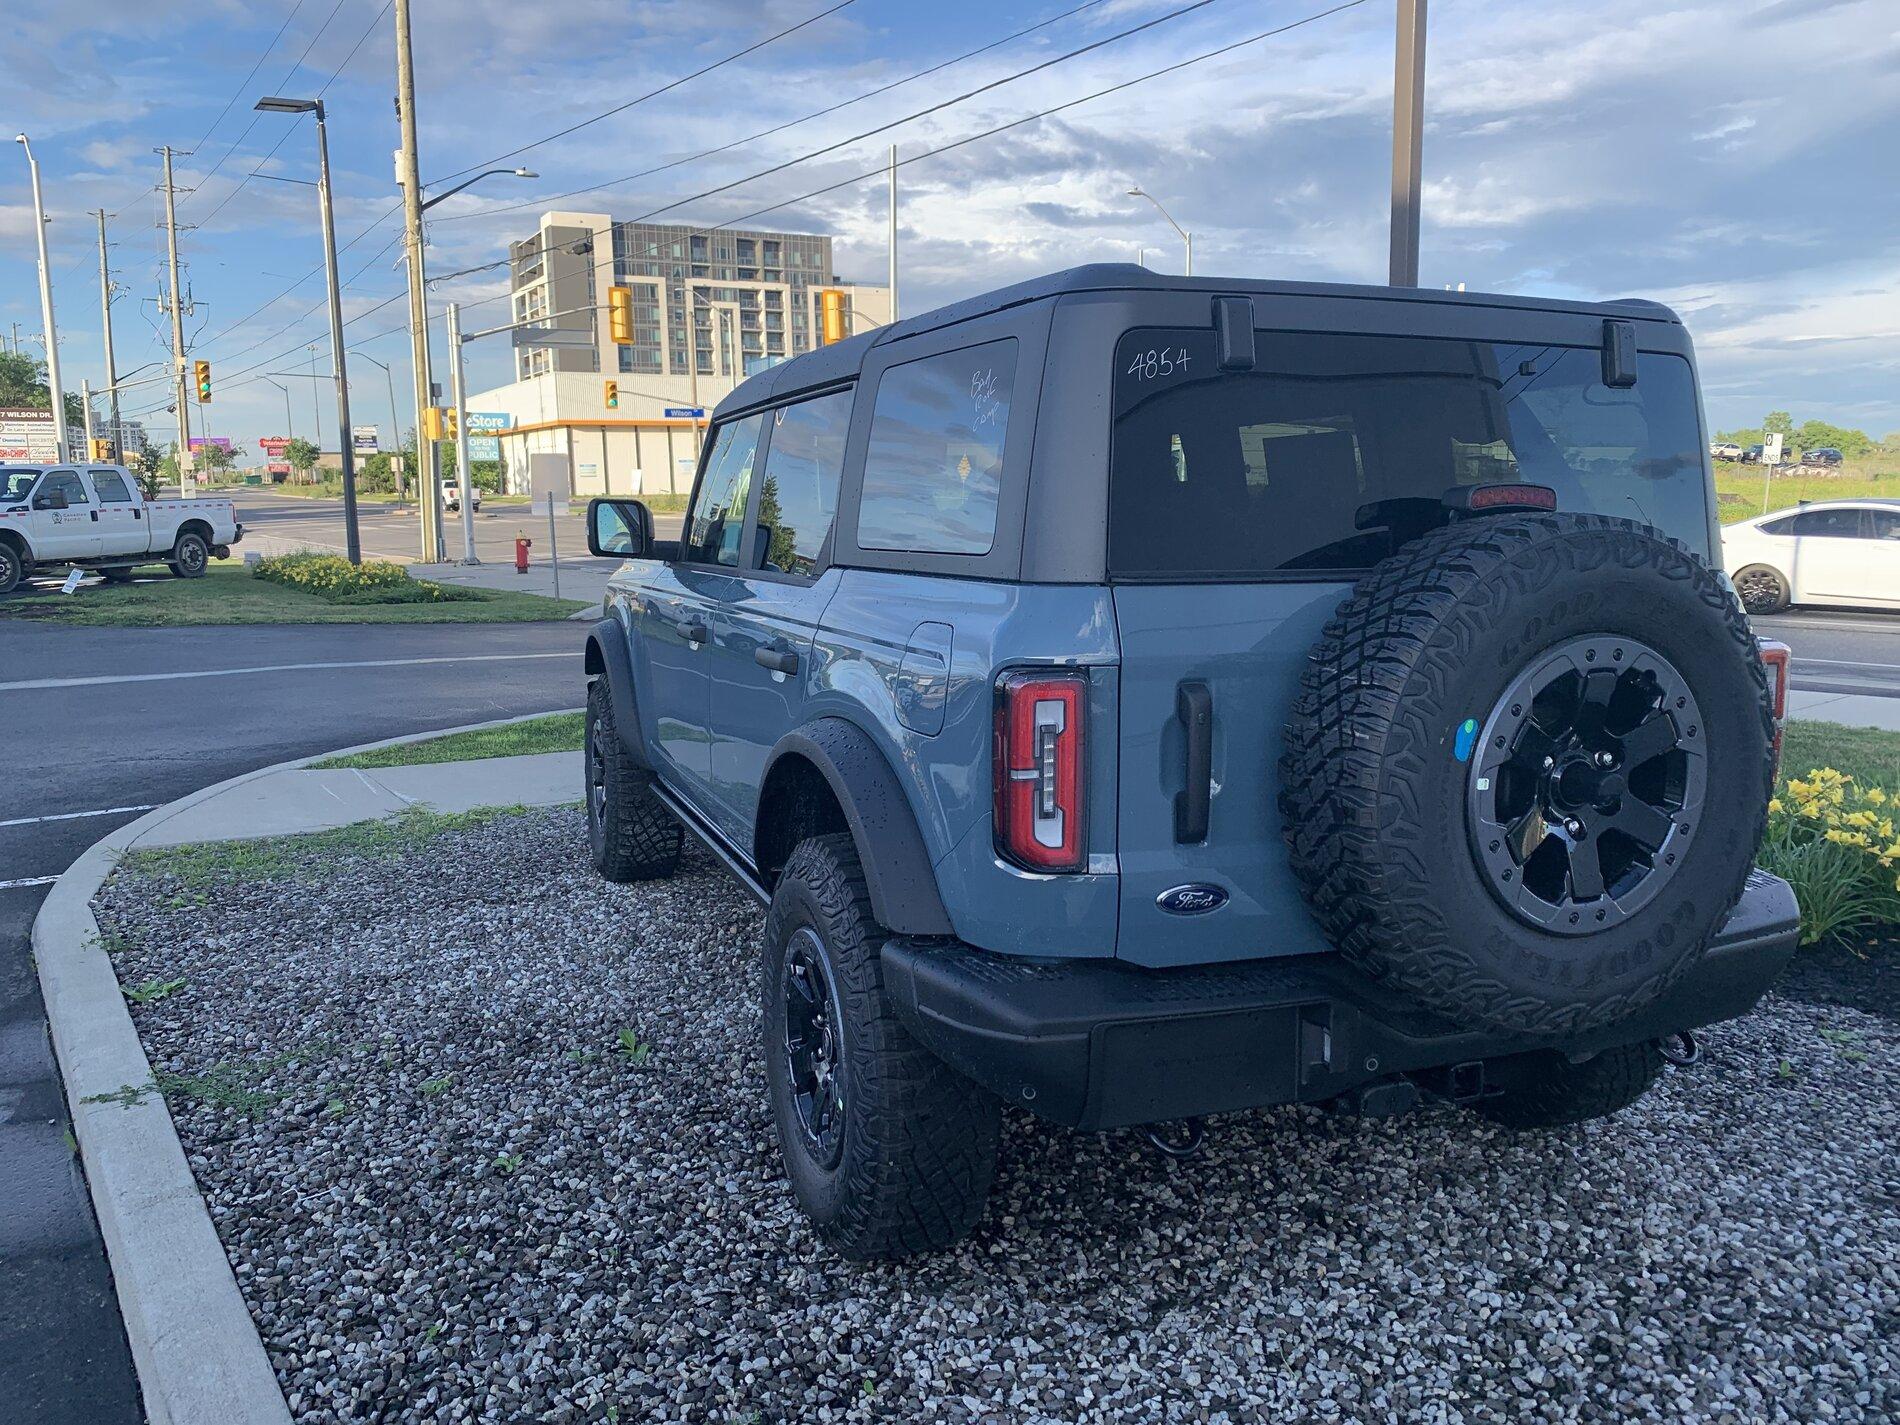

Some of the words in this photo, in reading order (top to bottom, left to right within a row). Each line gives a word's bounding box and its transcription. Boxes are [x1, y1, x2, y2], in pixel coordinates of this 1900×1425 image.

[1127, 346, 1192, 381] 4854
[39, 411, 53, 419] DR.
[670, 409, 693, 417] Wilson
[465, 413, 505, 428] eStore
[469, 438, 496, 447] OPEN
[468, 451, 499, 460] PUBLIC
[1764, 454, 1779, 462] ENDS
